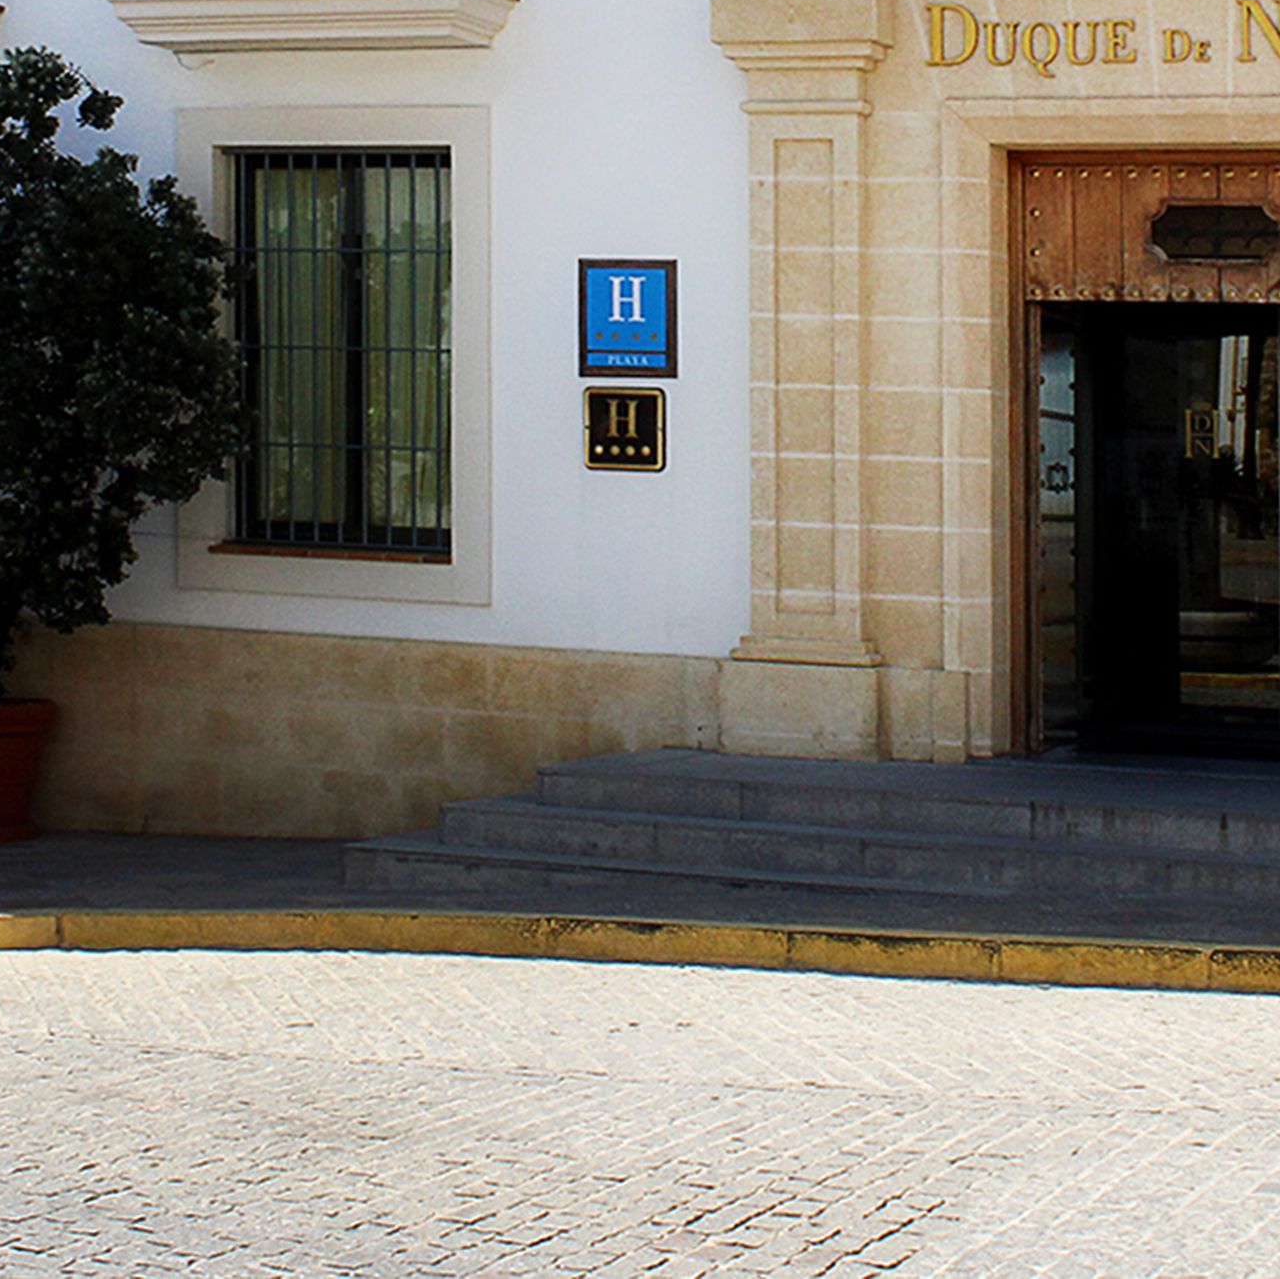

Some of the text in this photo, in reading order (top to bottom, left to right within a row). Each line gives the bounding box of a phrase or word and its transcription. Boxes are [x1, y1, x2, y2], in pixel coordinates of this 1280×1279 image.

[925, 1, 1138, 79] DUQUE
[608, 275, 647, 323] H
[606, 354, 649, 366] PLAYA
[606, 398, 639, 438] H
